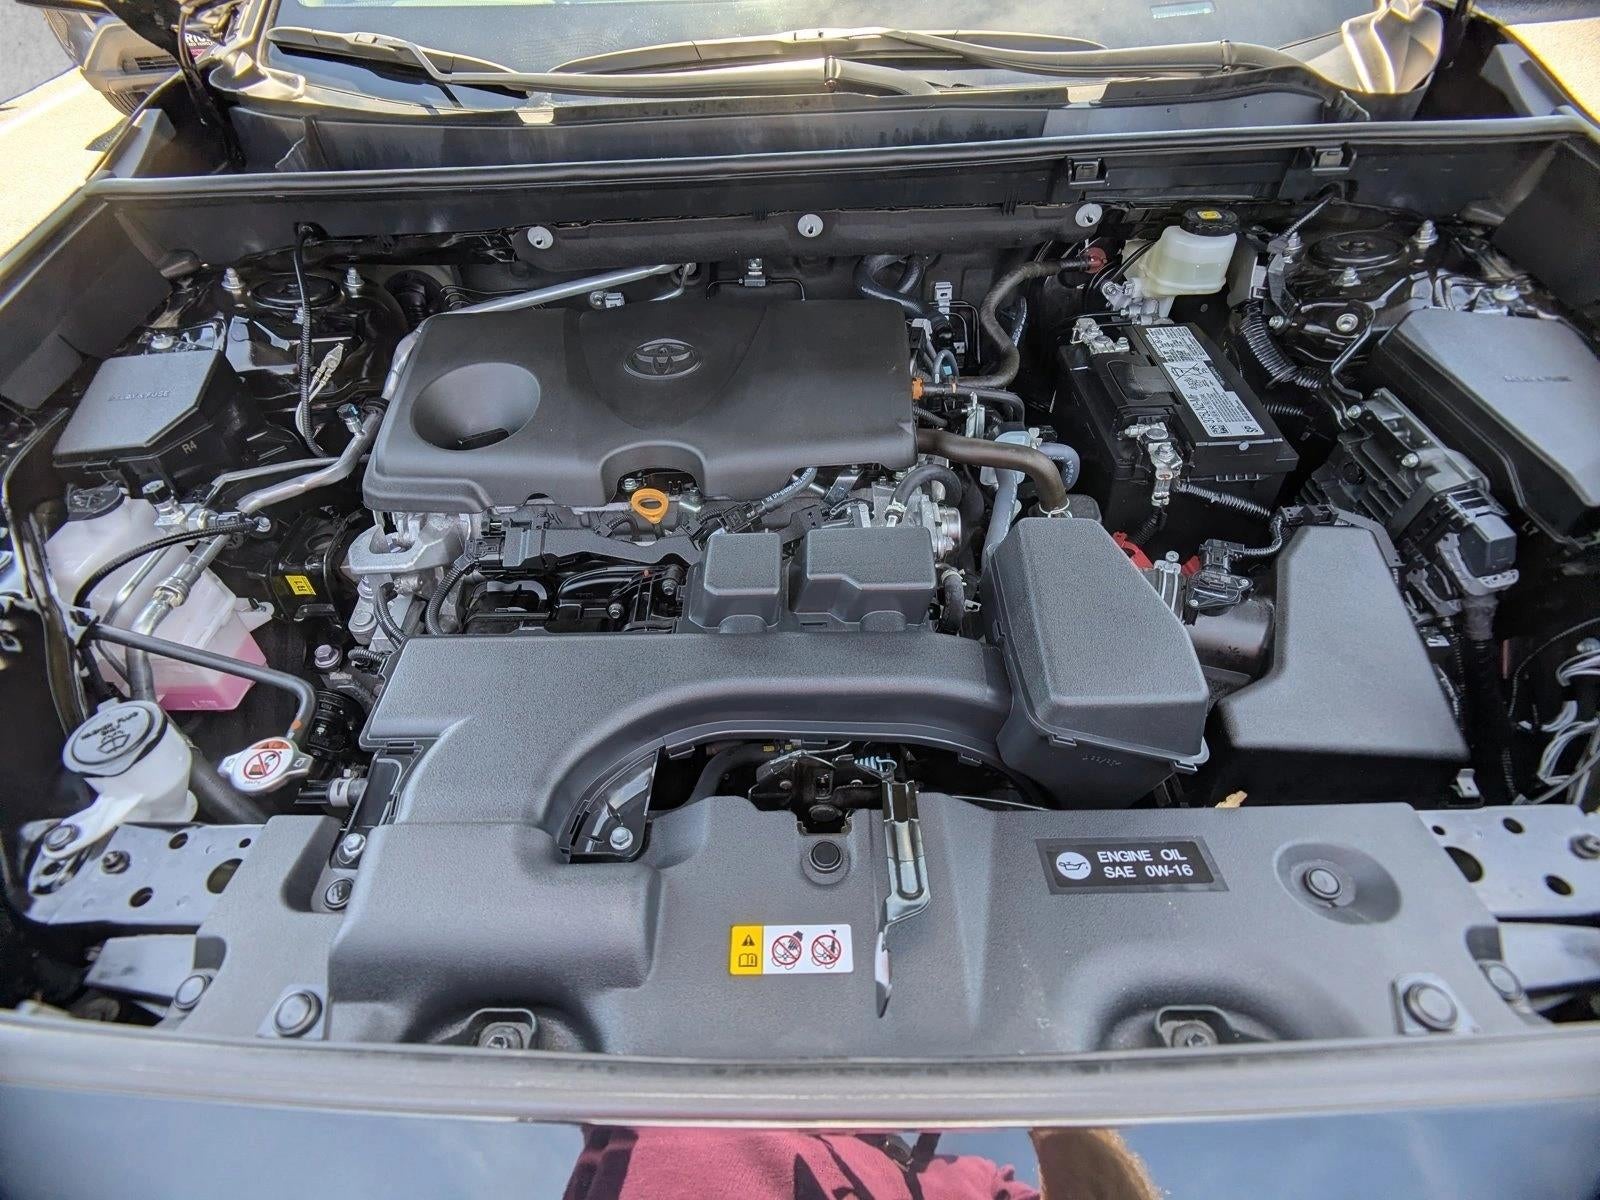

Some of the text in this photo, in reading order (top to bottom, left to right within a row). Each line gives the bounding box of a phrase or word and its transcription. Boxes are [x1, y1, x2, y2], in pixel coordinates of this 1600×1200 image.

[181, 440, 197, 454] R4
[1097, 849, 1187, 863] ENGINE OIL
[1103, 864, 1194, 878] SAE 0W-16
